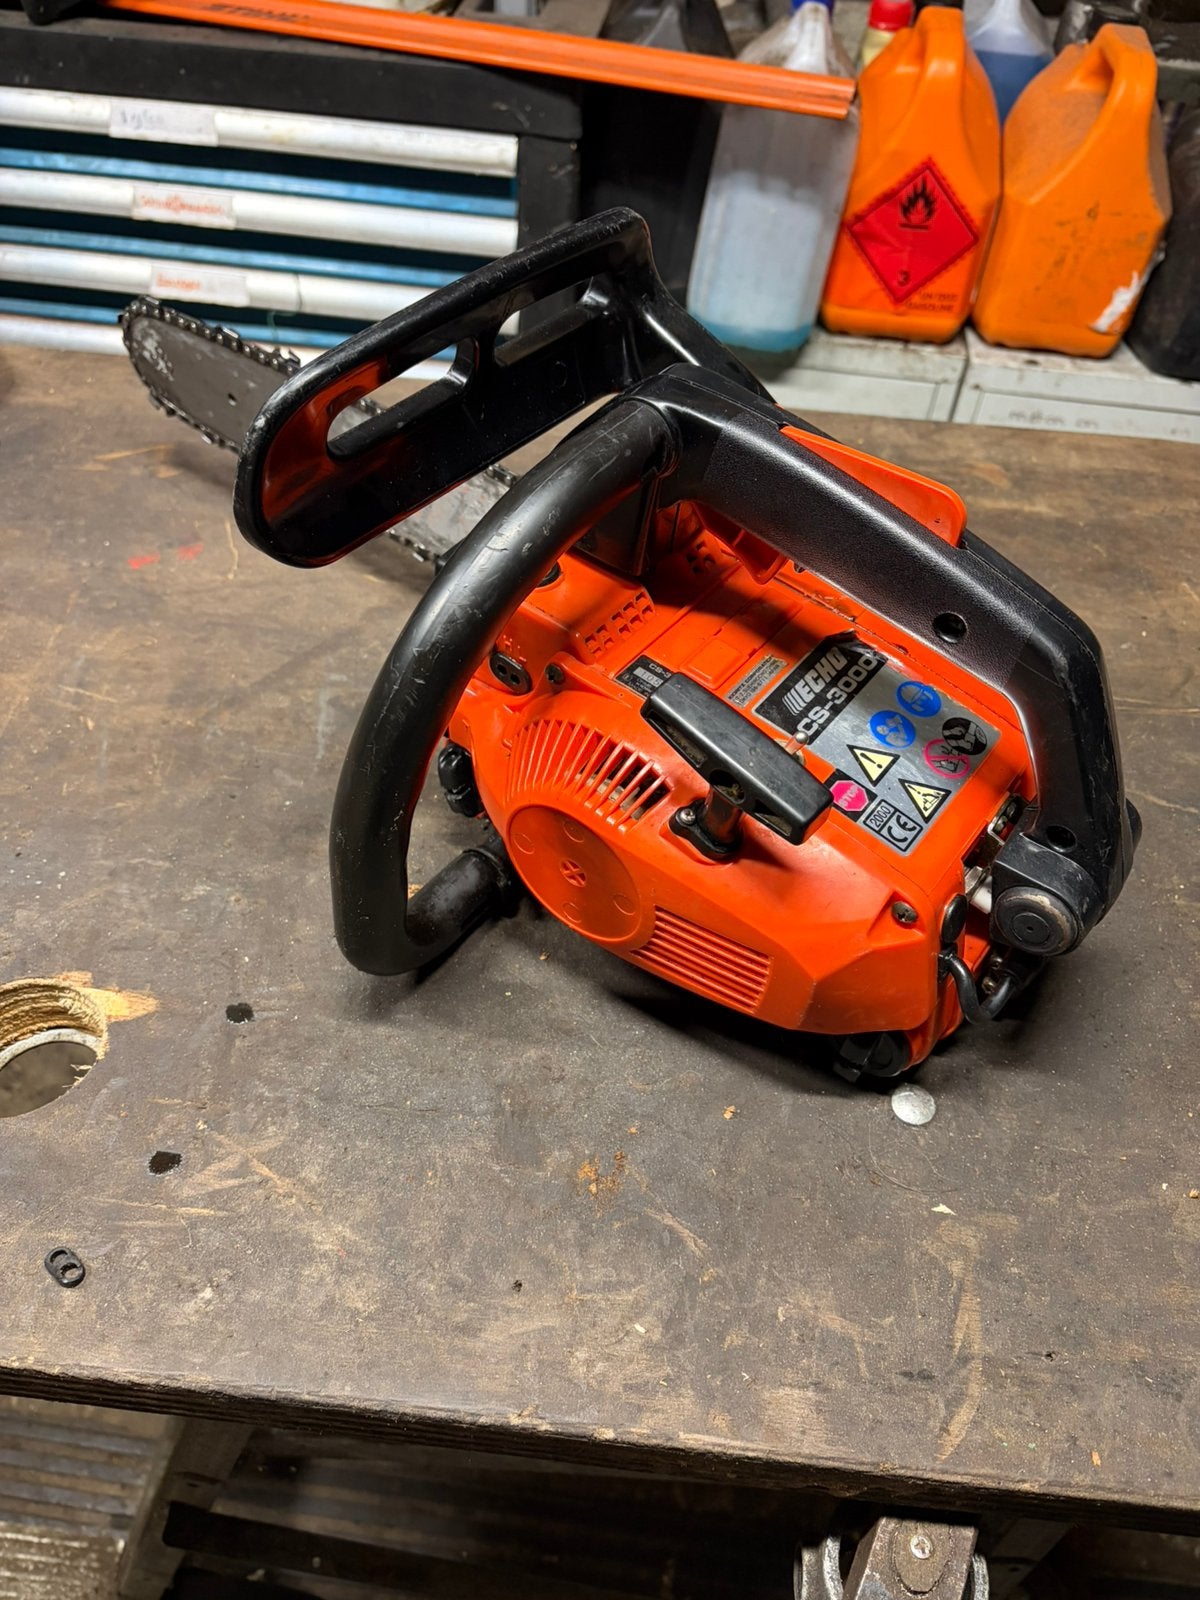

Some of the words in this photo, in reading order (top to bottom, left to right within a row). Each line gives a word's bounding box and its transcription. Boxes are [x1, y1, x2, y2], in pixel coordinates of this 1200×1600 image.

[896, 270, 910, 287] 3
[640, 671, 661, 686] 105
[648, 663, 672, 679] CS-3
[787, 646, 848, 712] ECHO
[796, 654, 878, 736] CS-3000
[838, 784, 860, 808] STOP
[869, 805, 892, 828] 2000
[887, 814, 917, 843] CE
